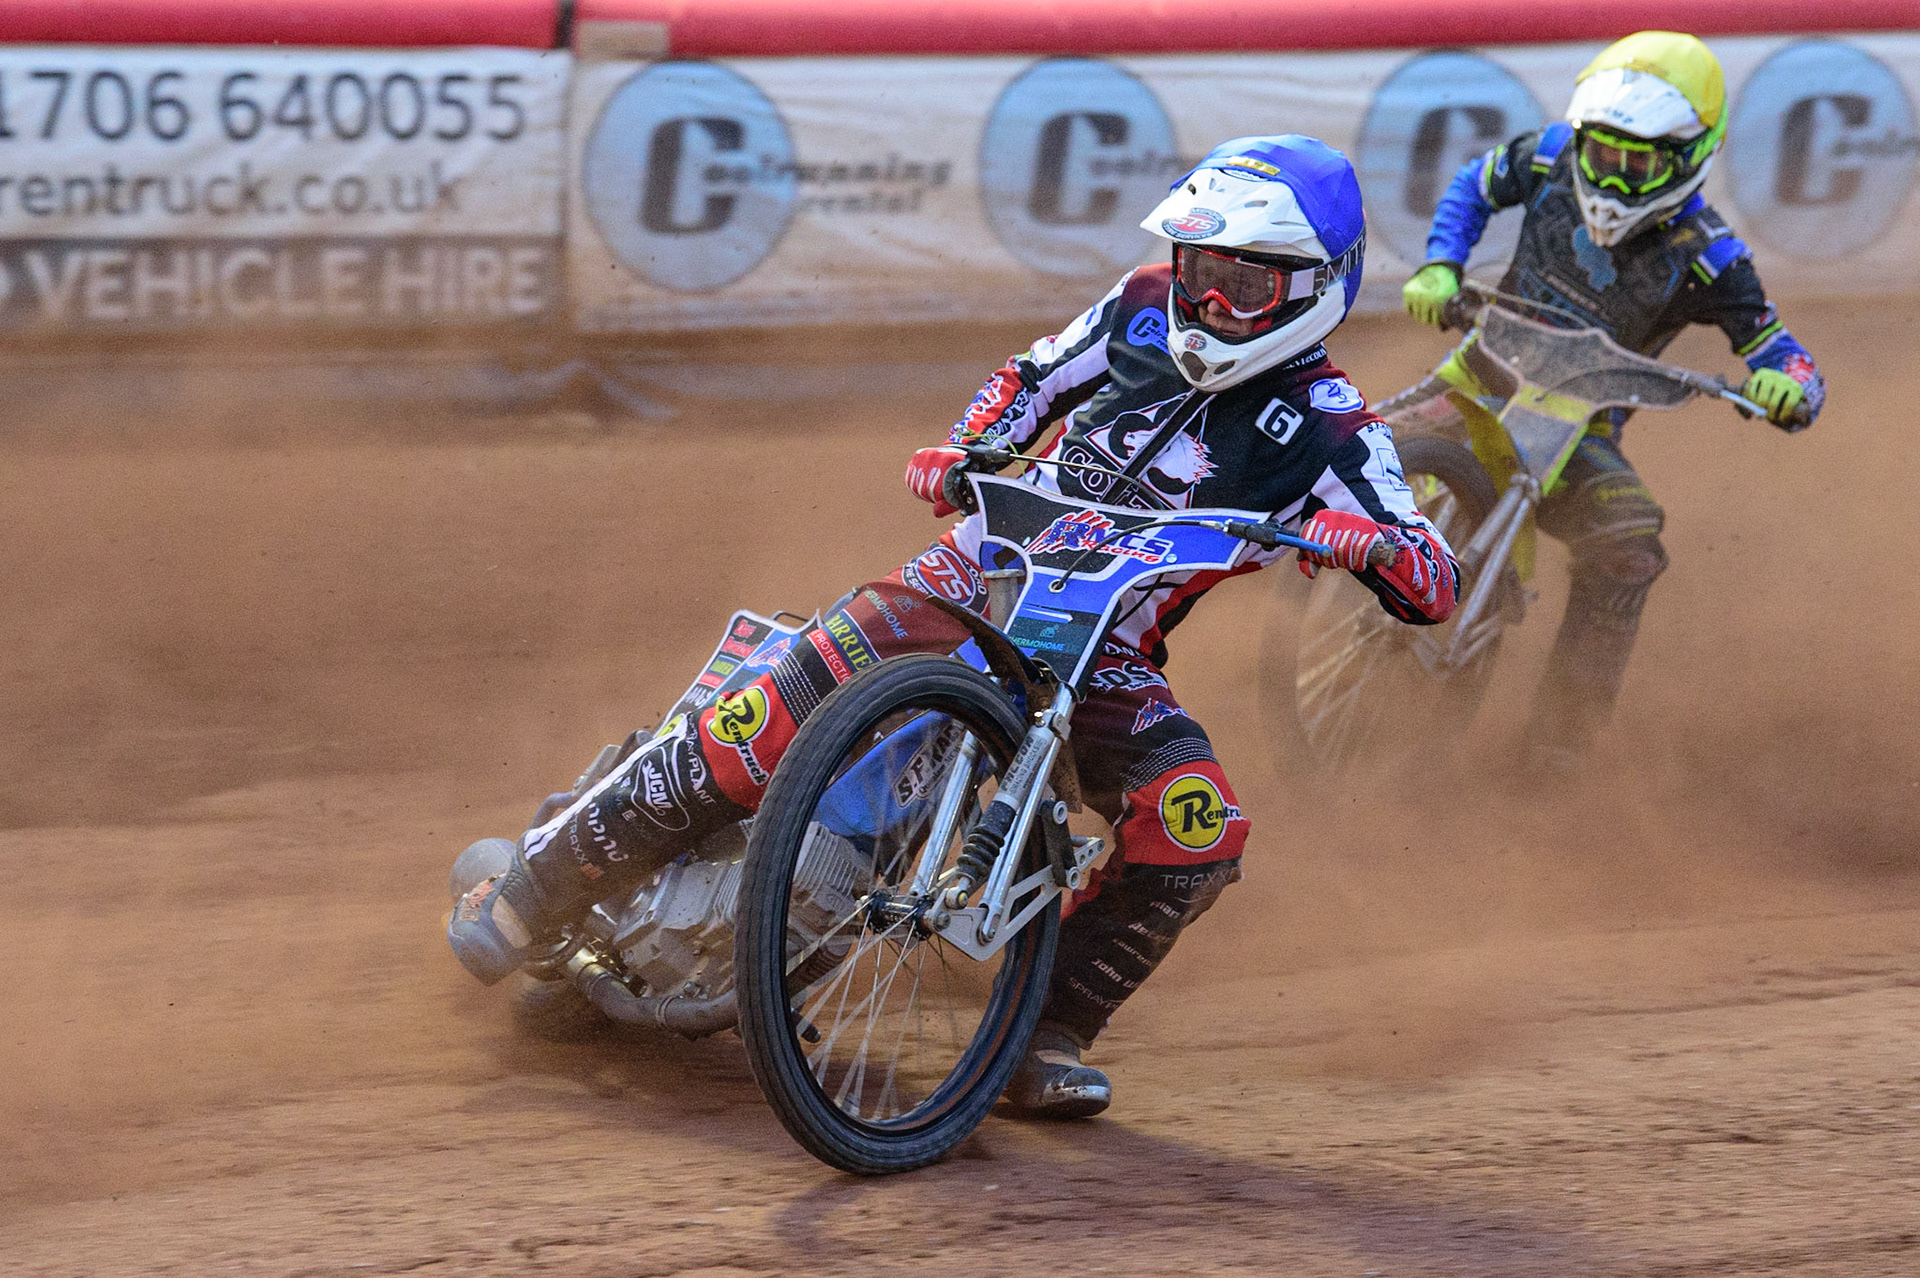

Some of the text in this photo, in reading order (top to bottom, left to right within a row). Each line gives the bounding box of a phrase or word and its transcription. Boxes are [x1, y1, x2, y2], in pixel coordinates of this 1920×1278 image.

[218, 72, 526, 143] 640055
[22, 249, 372, 320] VEHICLE
[383, 247, 550, 316] HIRE
[919, 550, 973, 600] STS
